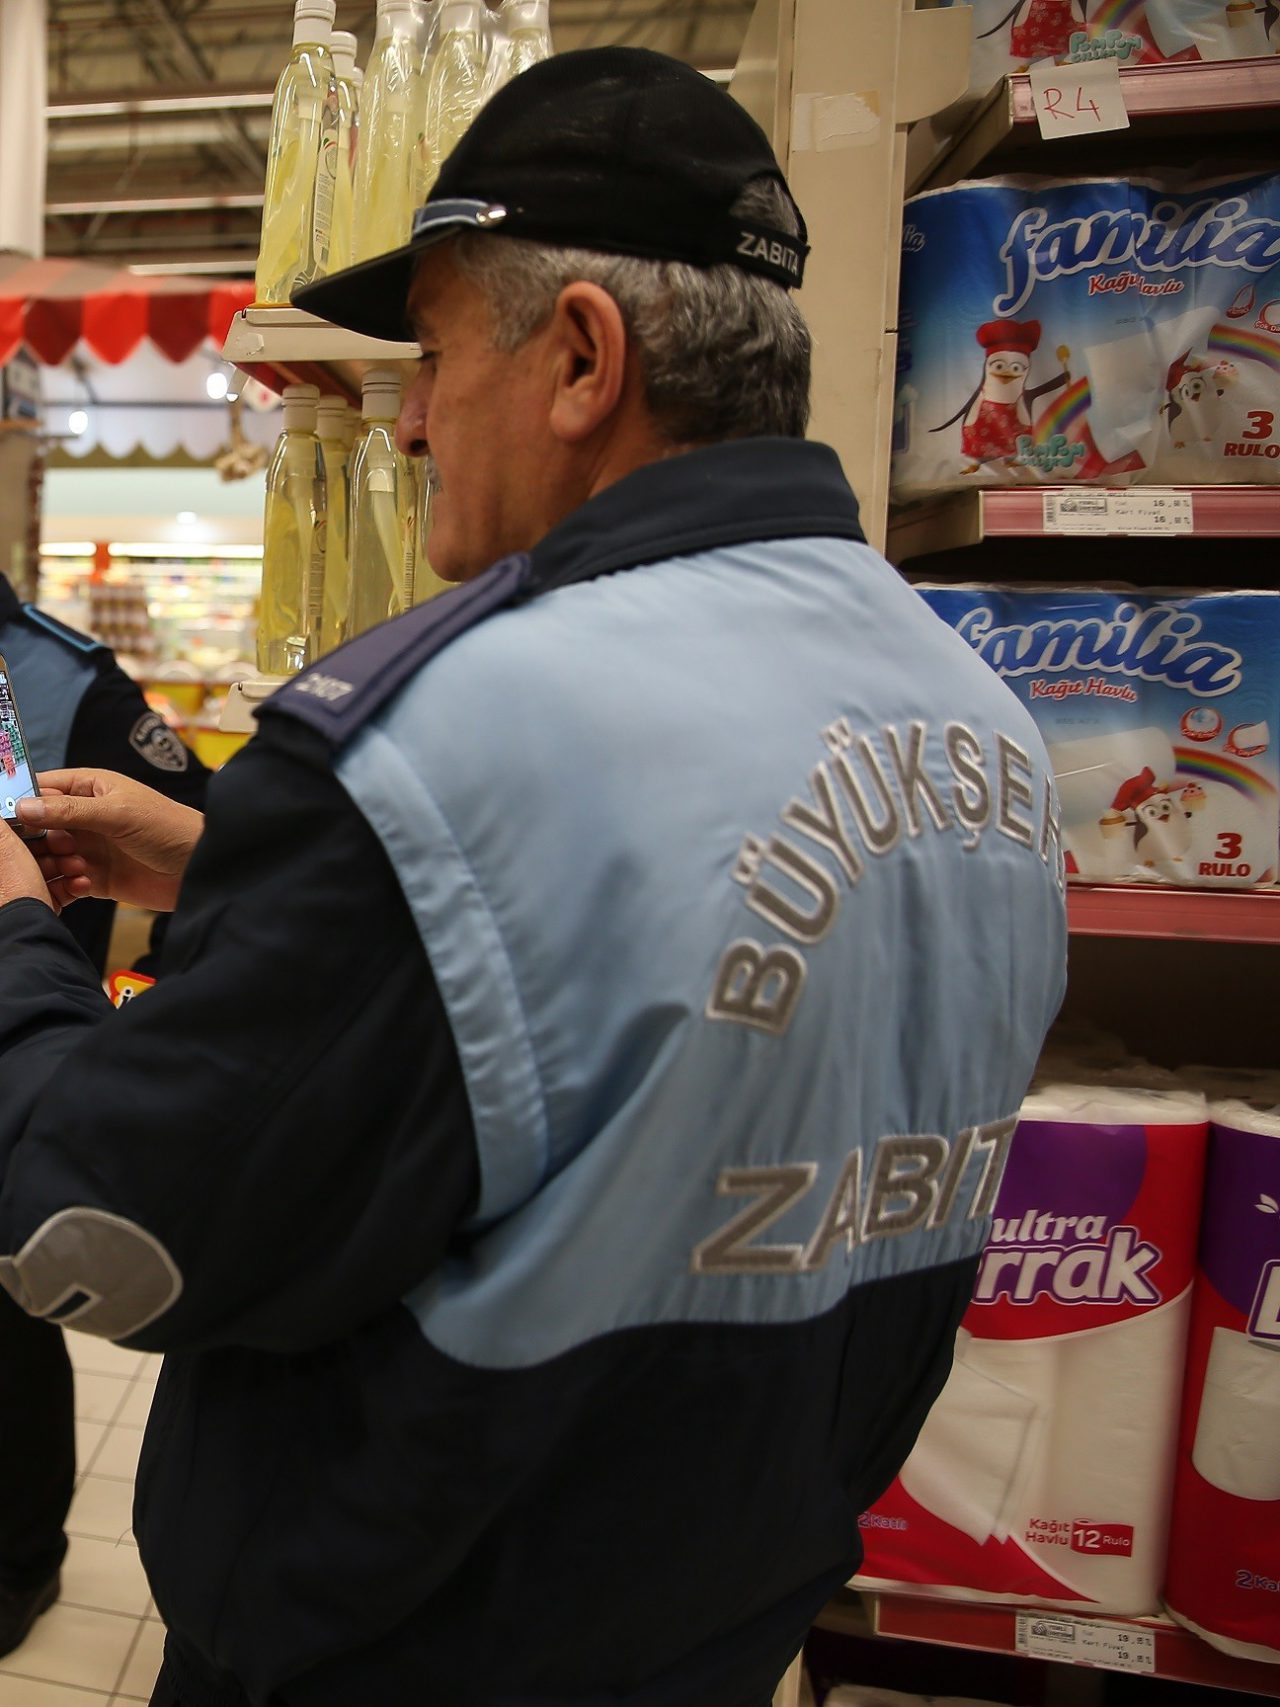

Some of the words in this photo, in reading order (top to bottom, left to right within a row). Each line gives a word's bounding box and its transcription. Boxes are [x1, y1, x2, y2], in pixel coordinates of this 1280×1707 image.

[736, 231, 799, 276] ZABITA
[993, 197, 1280, 318] familia
[1242, 410, 1273, 440] 3
[1223, 443, 1280, 459] RULO
[1030, 678, 1082, 701] Kağıt
[1085, 676, 1138, 704] Havlu
[1214, 832, 1243, 859] 3
[1198, 862, 1251, 877] RULO
[991, 1209, 1107, 1242] ultra
[974, 1228, 1160, 1302] rrak
[1025, 1531, 1070, 1546] Havlu
[1029, 1518, 1071, 1533] Kağıt
[1074, 1529, 1100, 1548] 12
[1102, 1534, 1131, 1547] Rulo
[1235, 1569, 1253, 1590] 2
